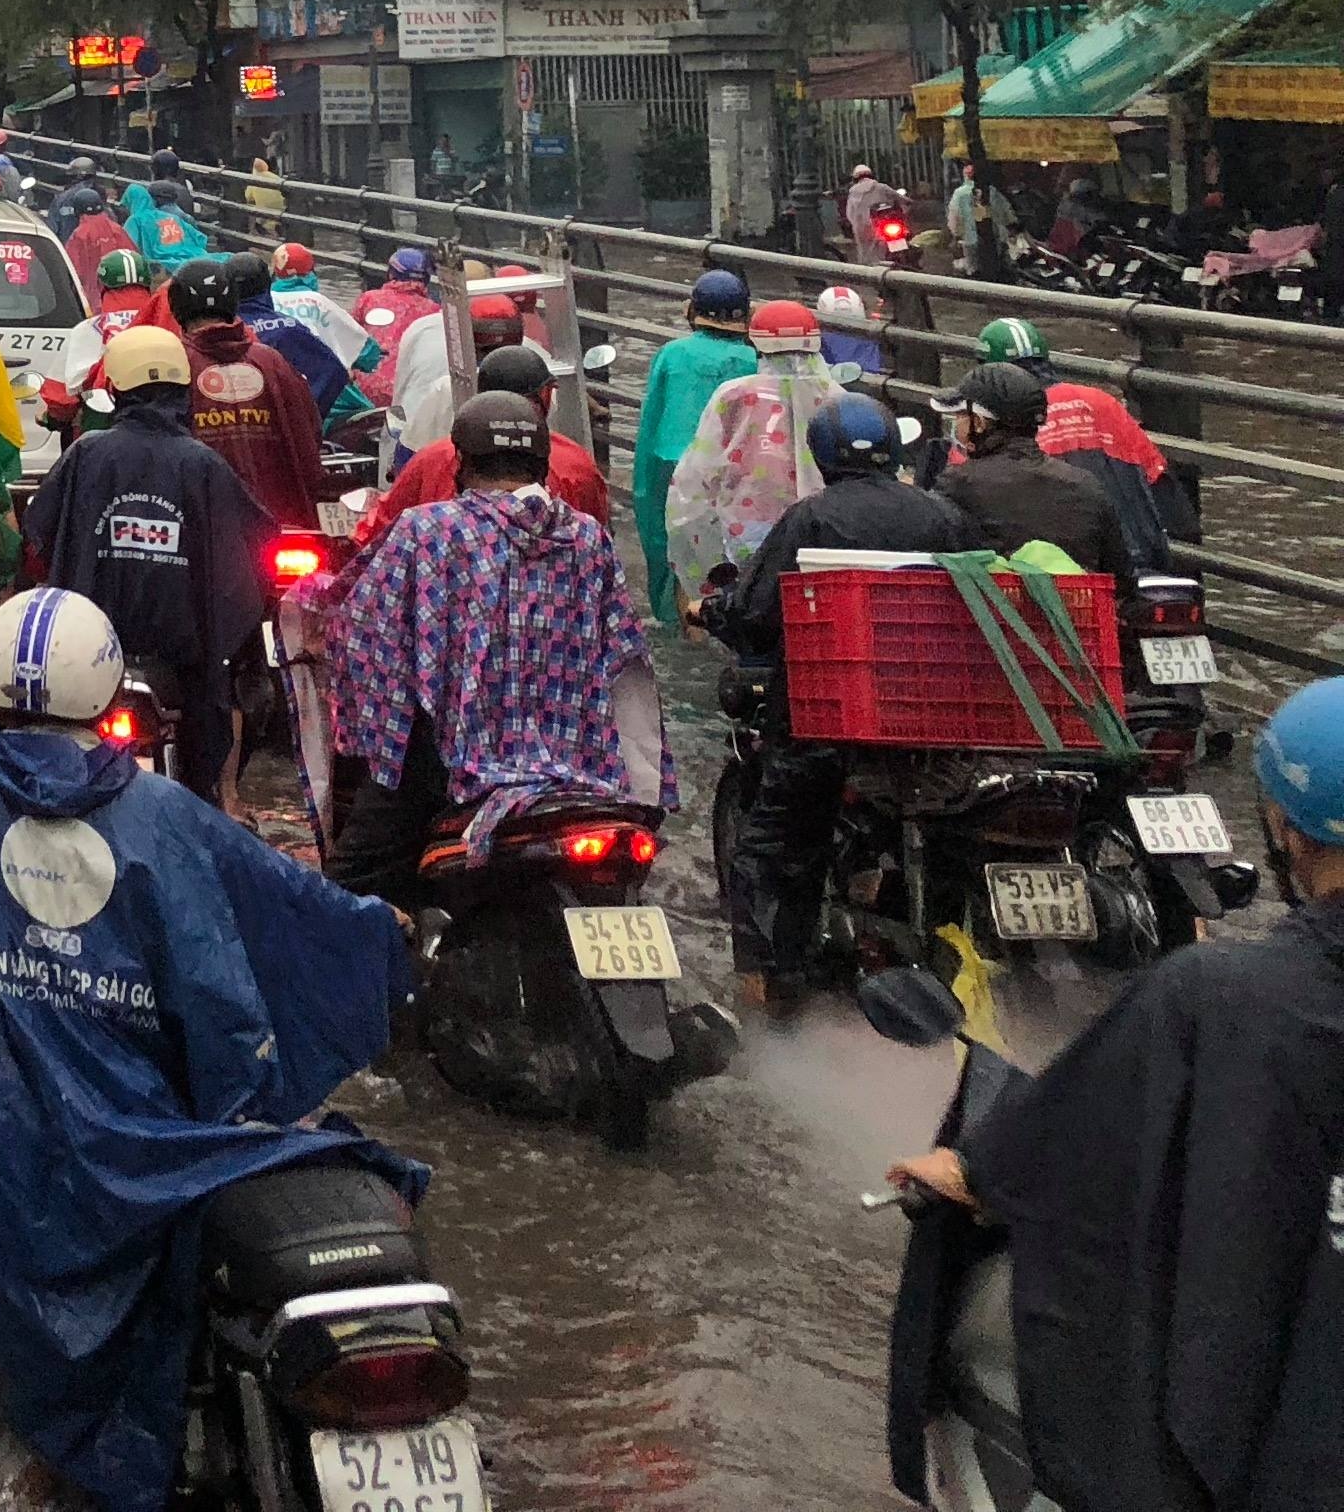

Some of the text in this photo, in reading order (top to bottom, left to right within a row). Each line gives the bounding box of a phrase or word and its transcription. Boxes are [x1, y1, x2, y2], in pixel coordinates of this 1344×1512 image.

[405, 11, 456, 25] THANH
[544, 8, 625, 27] THANH
[10, 334, 36, 350] 27
[41, 335, 66, 352] 27
[193, 407, 237, 427] TÔN
[580, 911, 656, 943] 54-K5
[593, 942, 666, 975] 2699
[308, 1243, 385, 1267] HONDA
[337, 1432, 459, 1492] 52-M9
